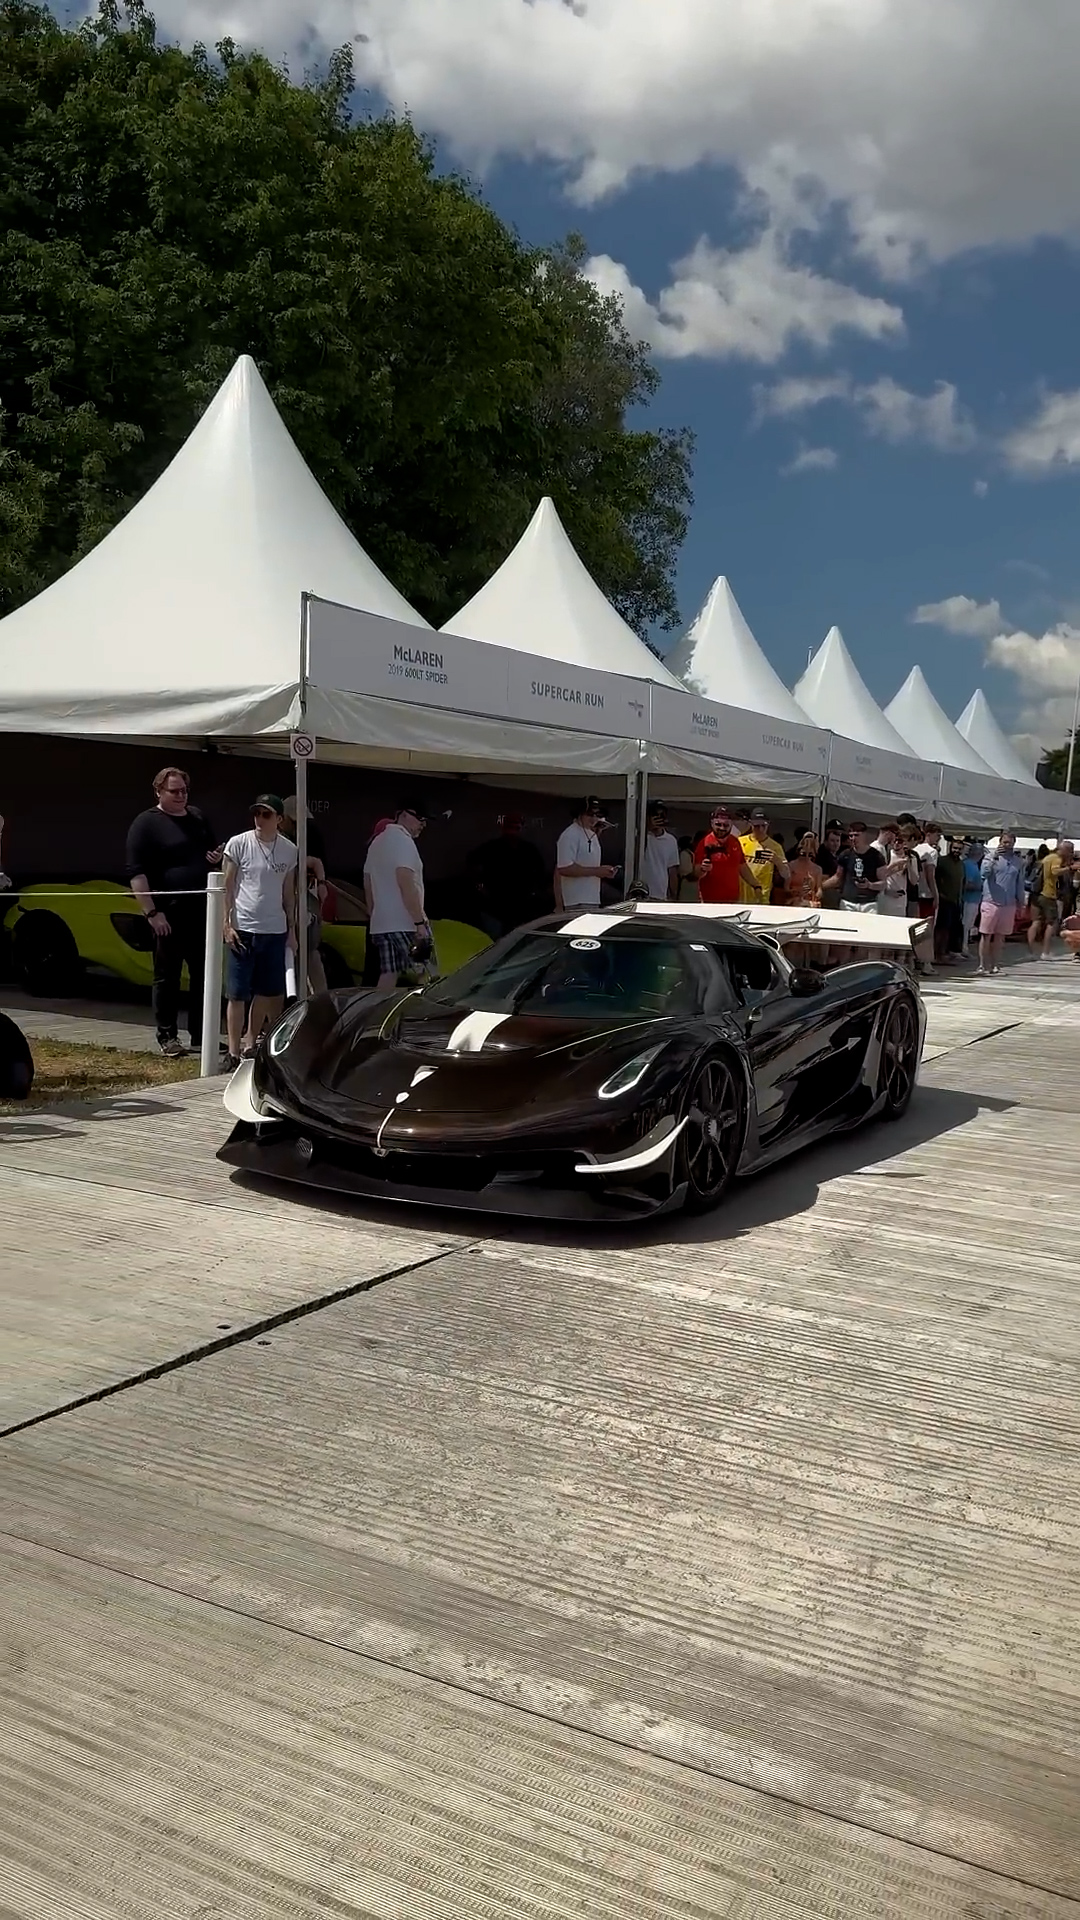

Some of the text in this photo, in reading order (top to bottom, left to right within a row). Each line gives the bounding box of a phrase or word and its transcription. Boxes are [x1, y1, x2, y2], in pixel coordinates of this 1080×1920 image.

[393, 644, 443, 669] McLAREN
[388, 663, 448, 684] 2019 600LT SPIDER
[531, 681, 604, 708] SUPERCAR RUN
